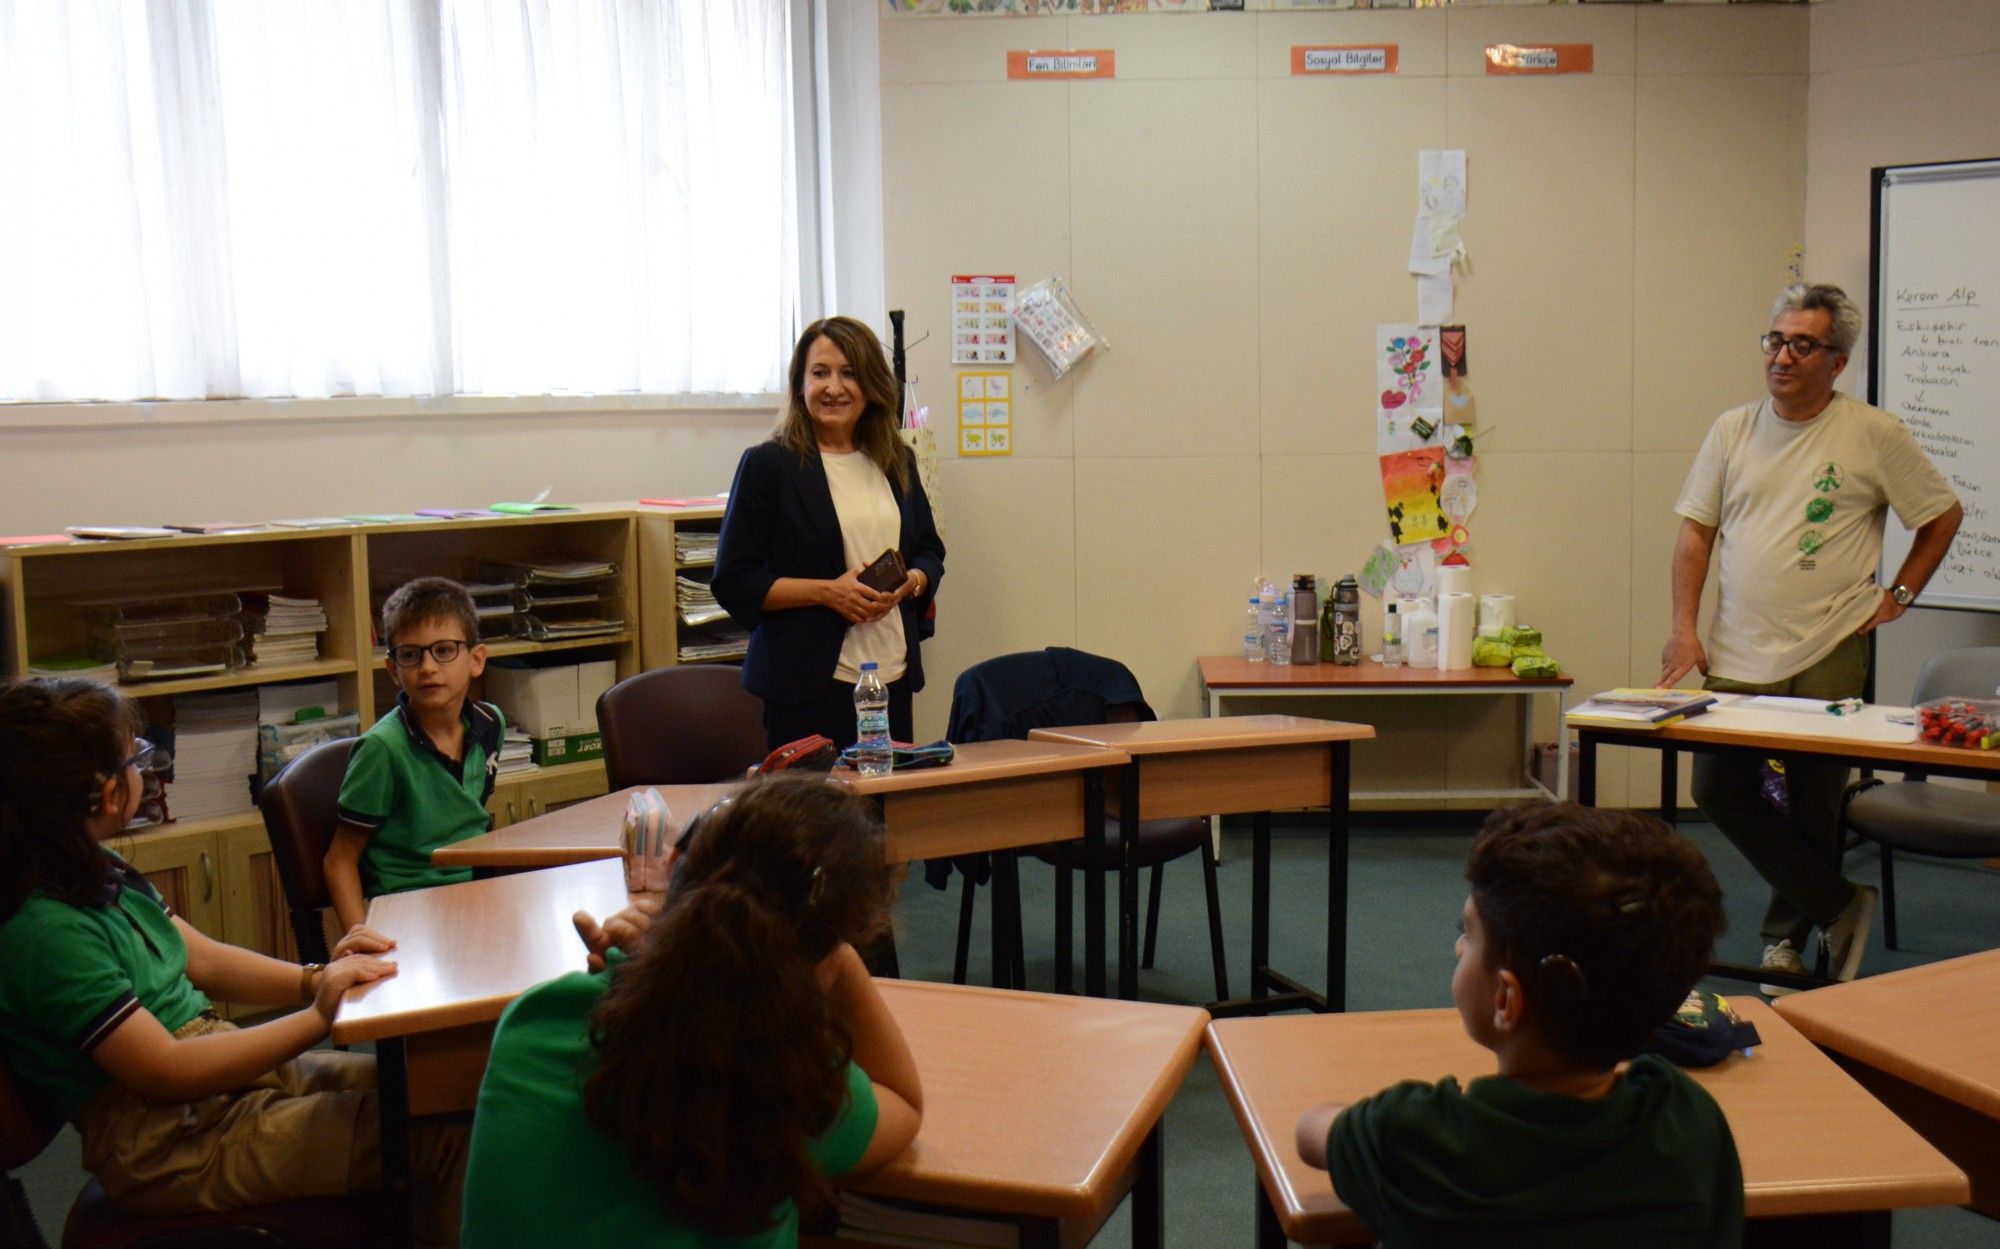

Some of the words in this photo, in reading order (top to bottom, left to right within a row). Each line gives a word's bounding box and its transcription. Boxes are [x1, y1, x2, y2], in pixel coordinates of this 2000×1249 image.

[1029, 59, 1049, 71] Fen
[1053, 58, 1096, 71] Bilimleri
[1306, 53, 1342, 70] Sosyal
[1345, 51, 1384, 68] Bilgiler
[1896, 288, 1939, 303] Kerem
[1946, 286, 1977, 307] Alp
